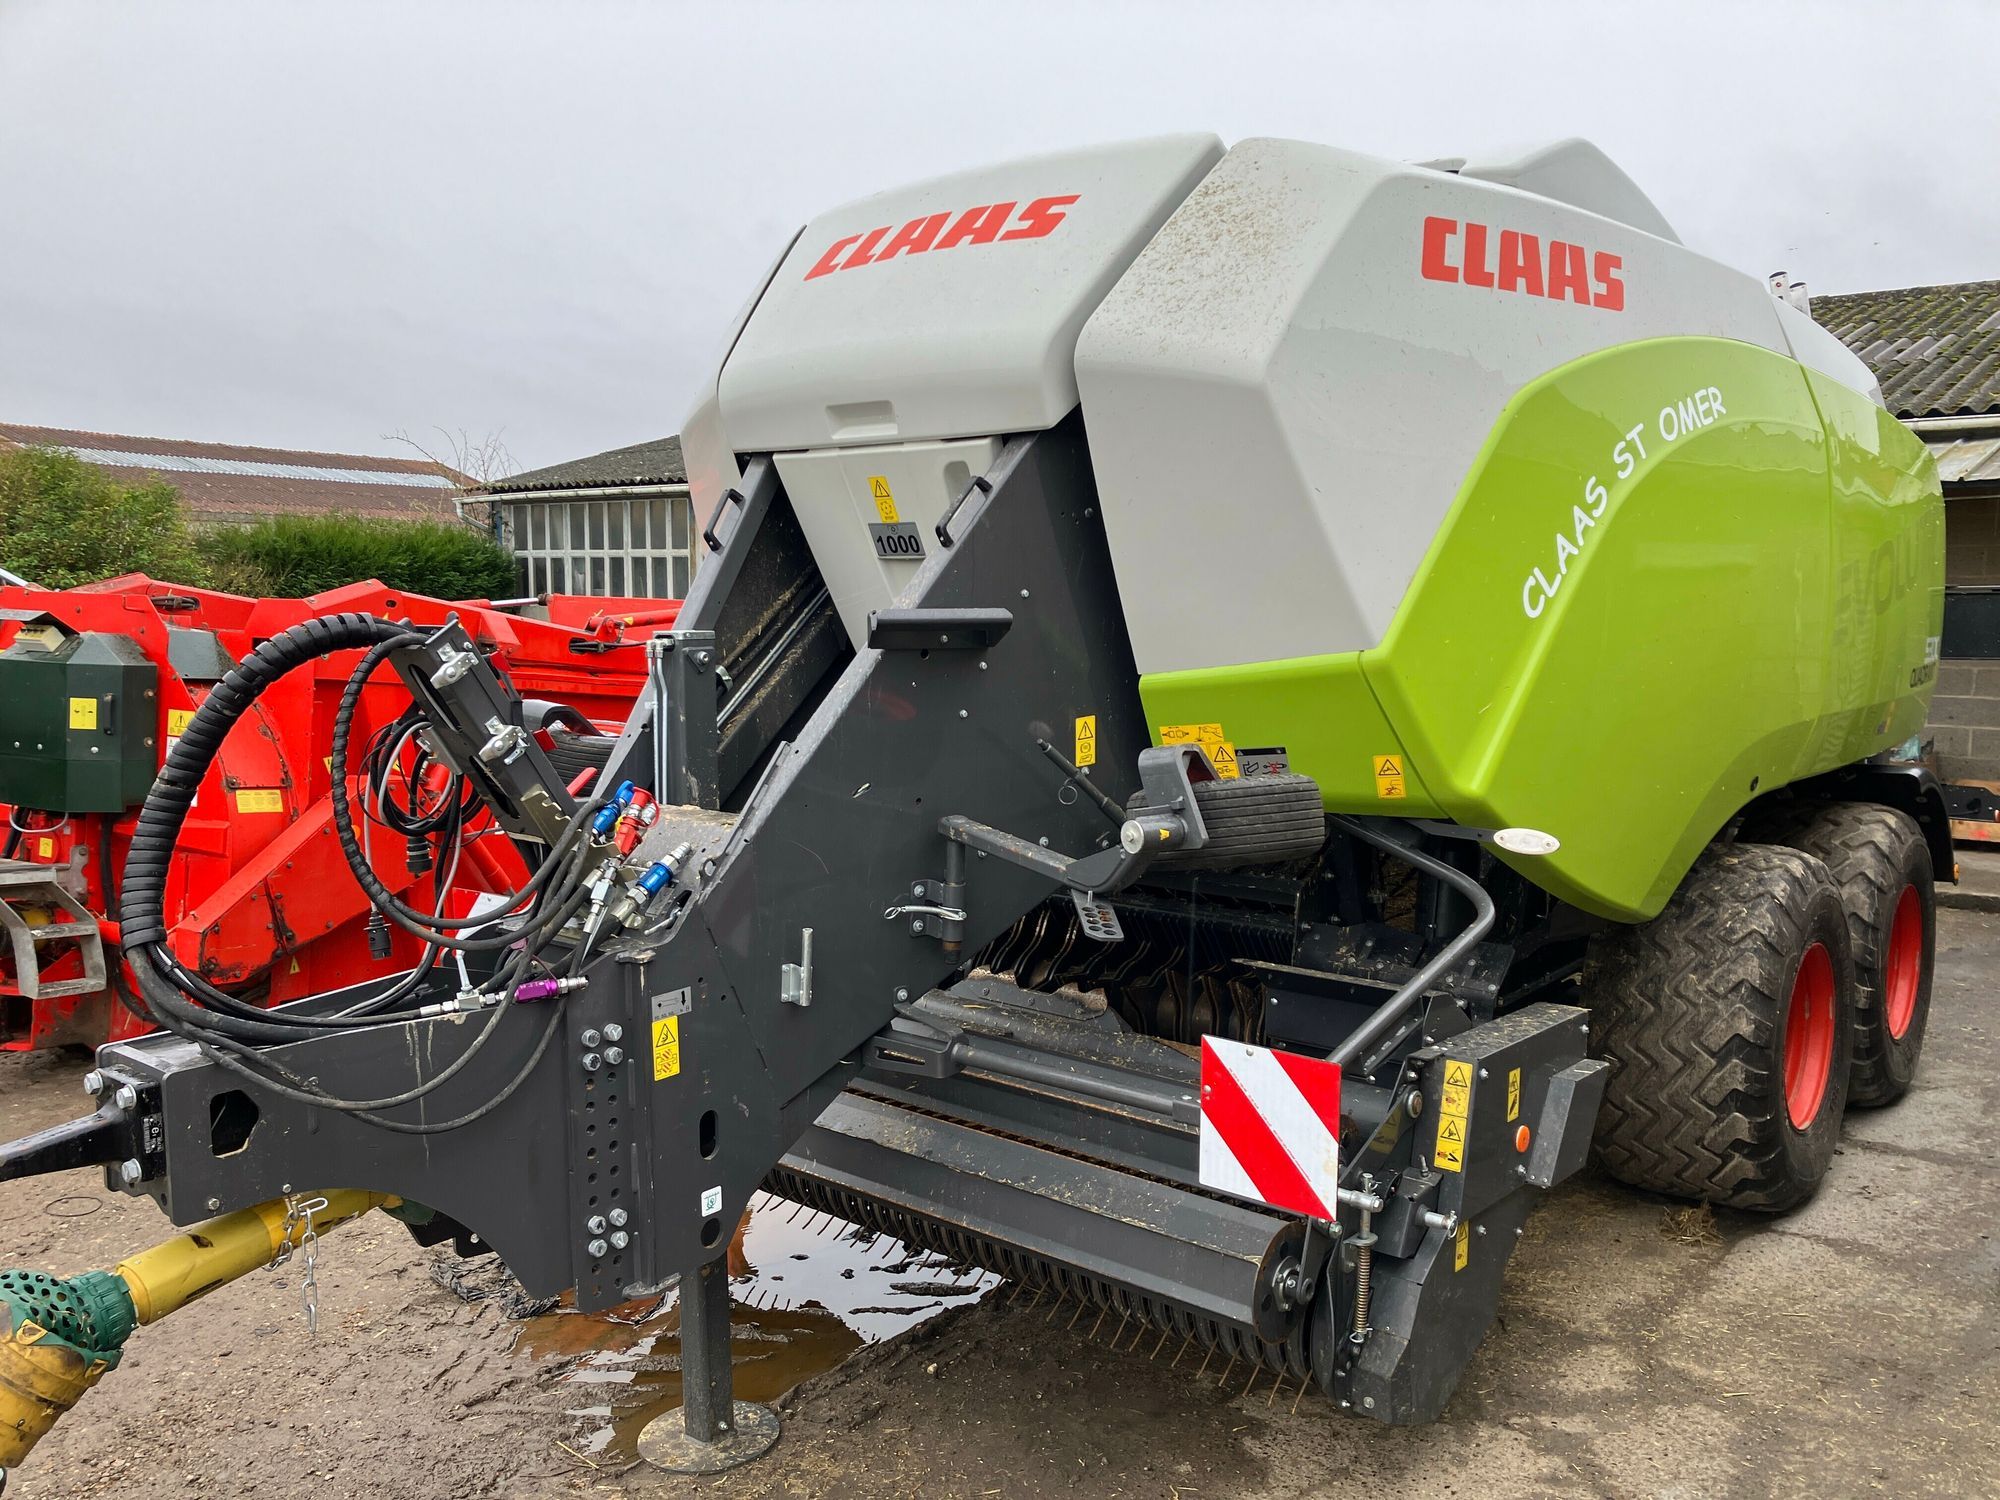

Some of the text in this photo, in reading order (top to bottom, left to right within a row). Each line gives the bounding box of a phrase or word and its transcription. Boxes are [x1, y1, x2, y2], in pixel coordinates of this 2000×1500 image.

[803, 194, 1082, 282] CLAAS
[1421, 216, 1624, 312] CLAAS
[876, 534, 920, 554] 1000
[1522, 386, 1727, 619] CLAAS ST OMER
